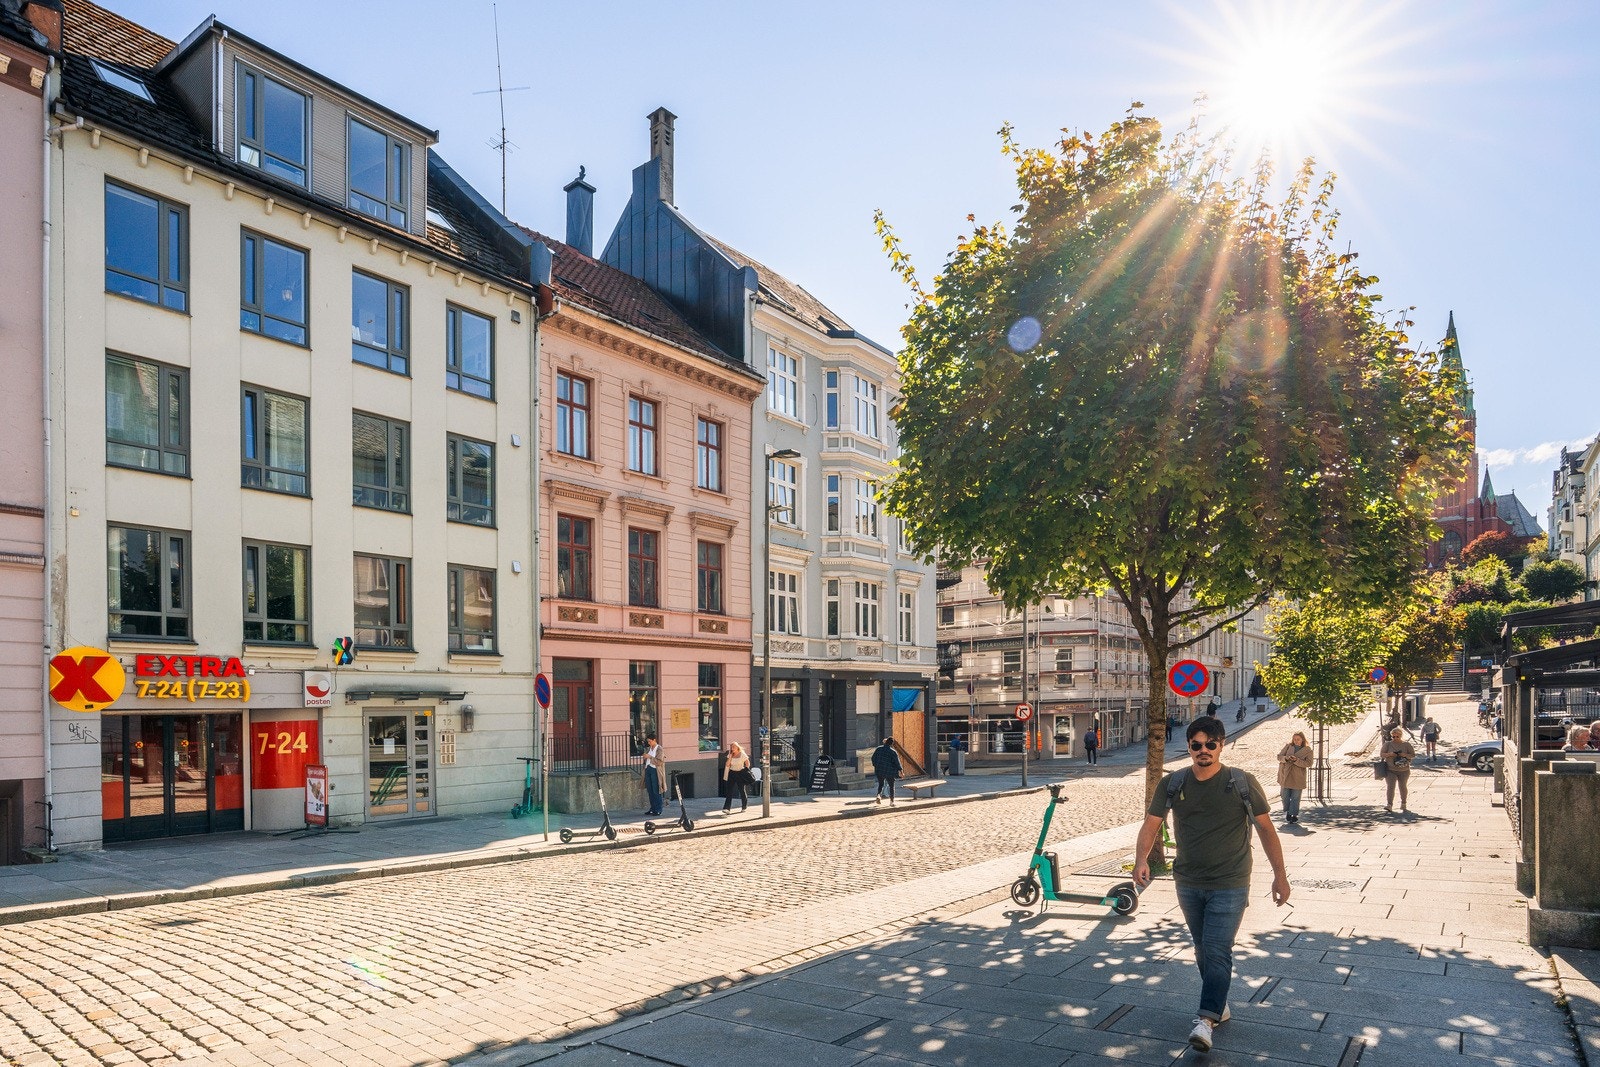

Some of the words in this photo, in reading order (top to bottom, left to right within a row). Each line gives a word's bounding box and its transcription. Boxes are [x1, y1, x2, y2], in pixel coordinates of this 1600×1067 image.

[136, 654, 246, 678] EXTRA
[306, 698, 331, 706] posten
[257, 731, 309, 755] 7-24
